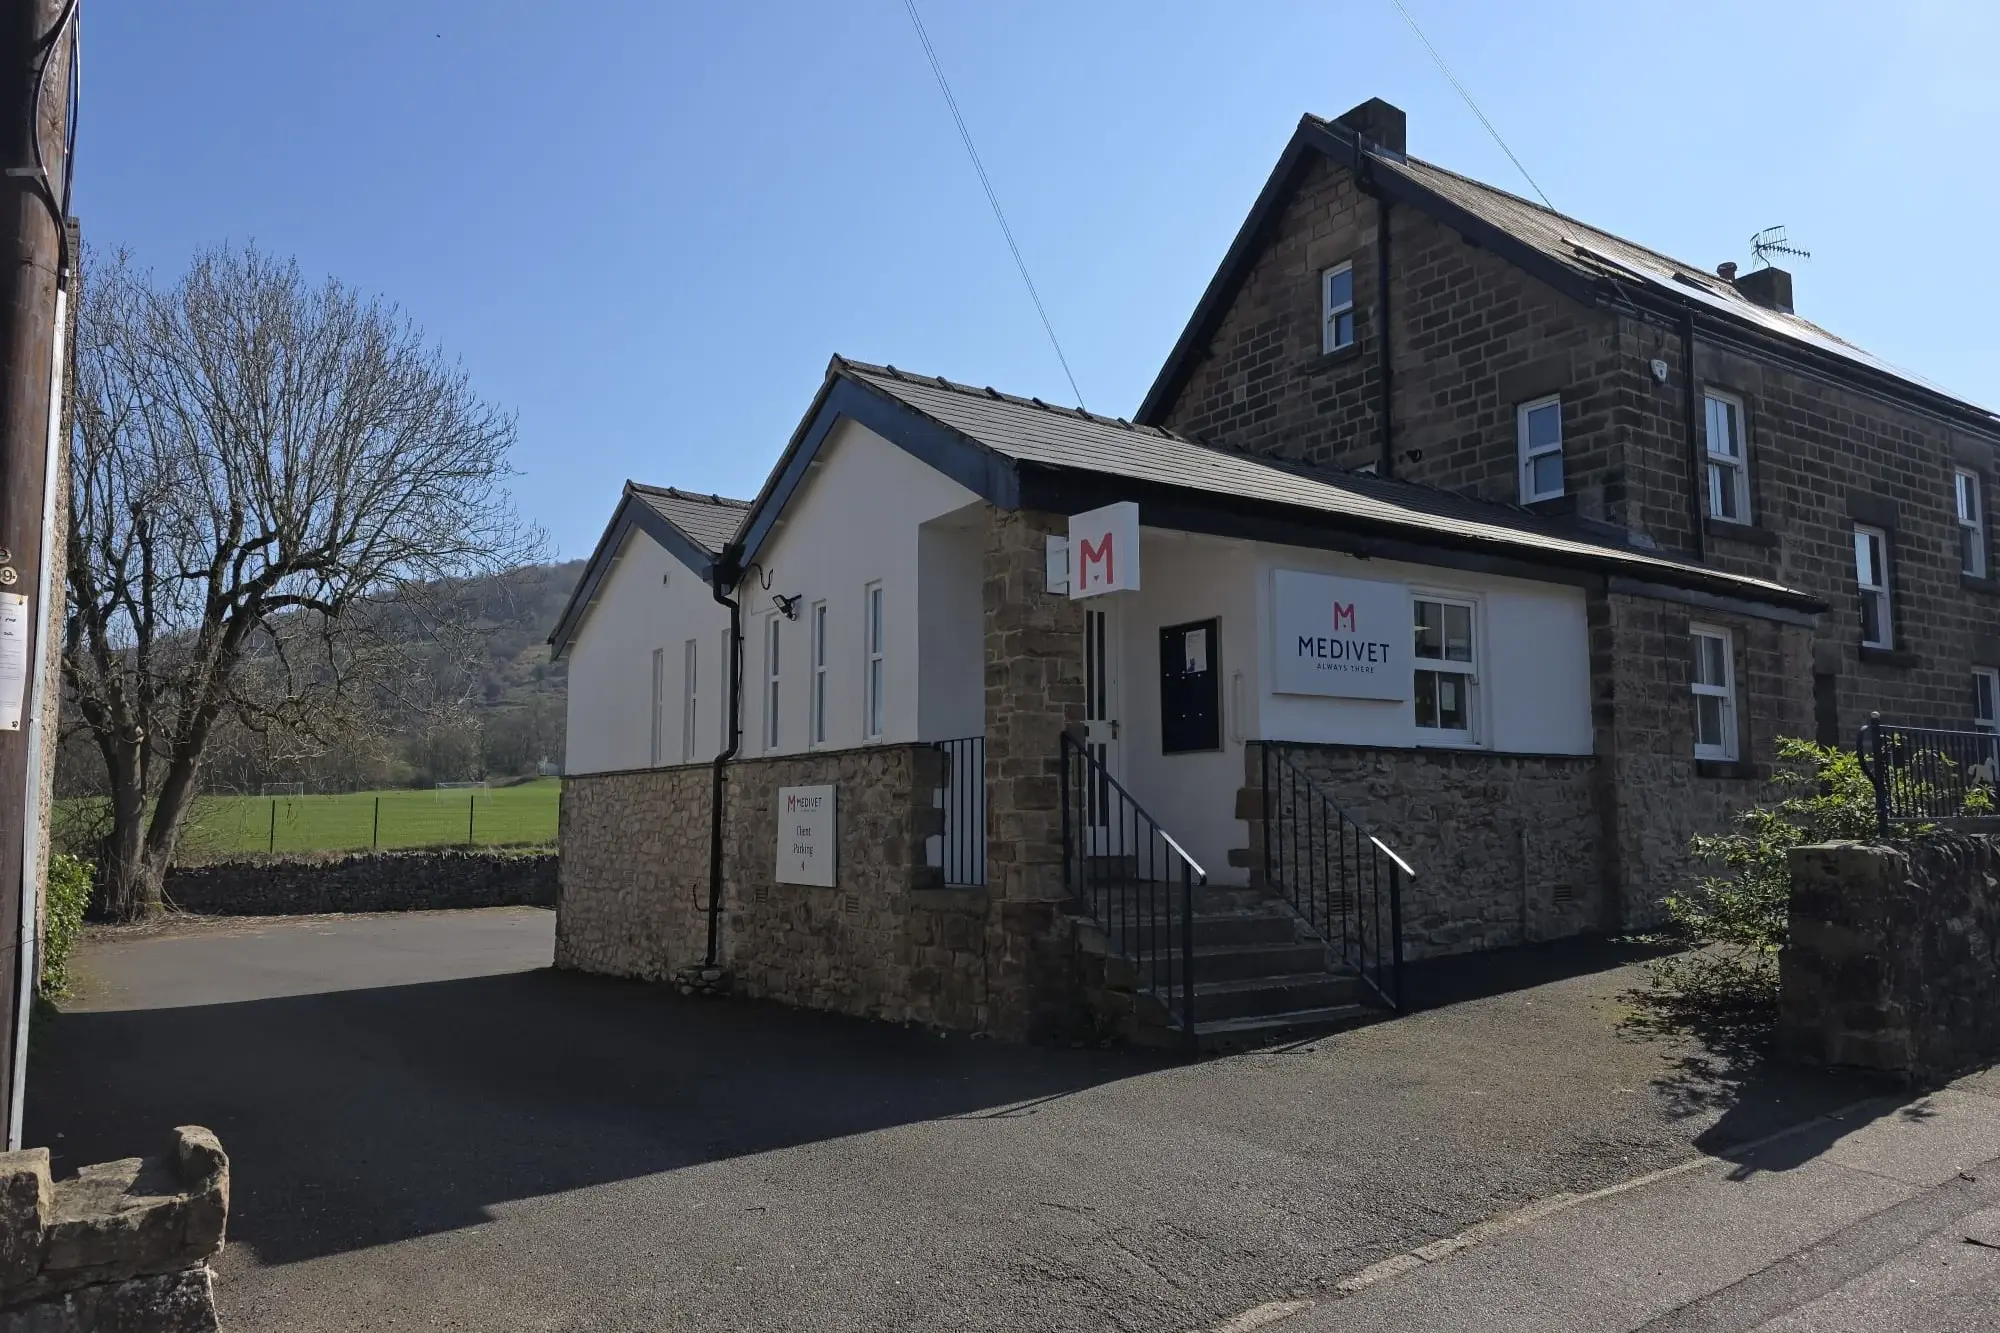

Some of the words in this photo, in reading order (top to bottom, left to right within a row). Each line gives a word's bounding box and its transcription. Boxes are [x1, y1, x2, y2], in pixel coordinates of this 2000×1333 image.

[1080, 532, 1114, 590] M
[1333, 601, 1355, 632] M
[1298, 636, 1390, 663] MEDIVET
[1317, 663, 1348, 672] ALWAYS
[1350, 665, 1375, 674] THERE
[796, 797, 822, 808] MEDIVET
[796, 825, 811, 837] Client
[793, 843, 814, 858] Parking
